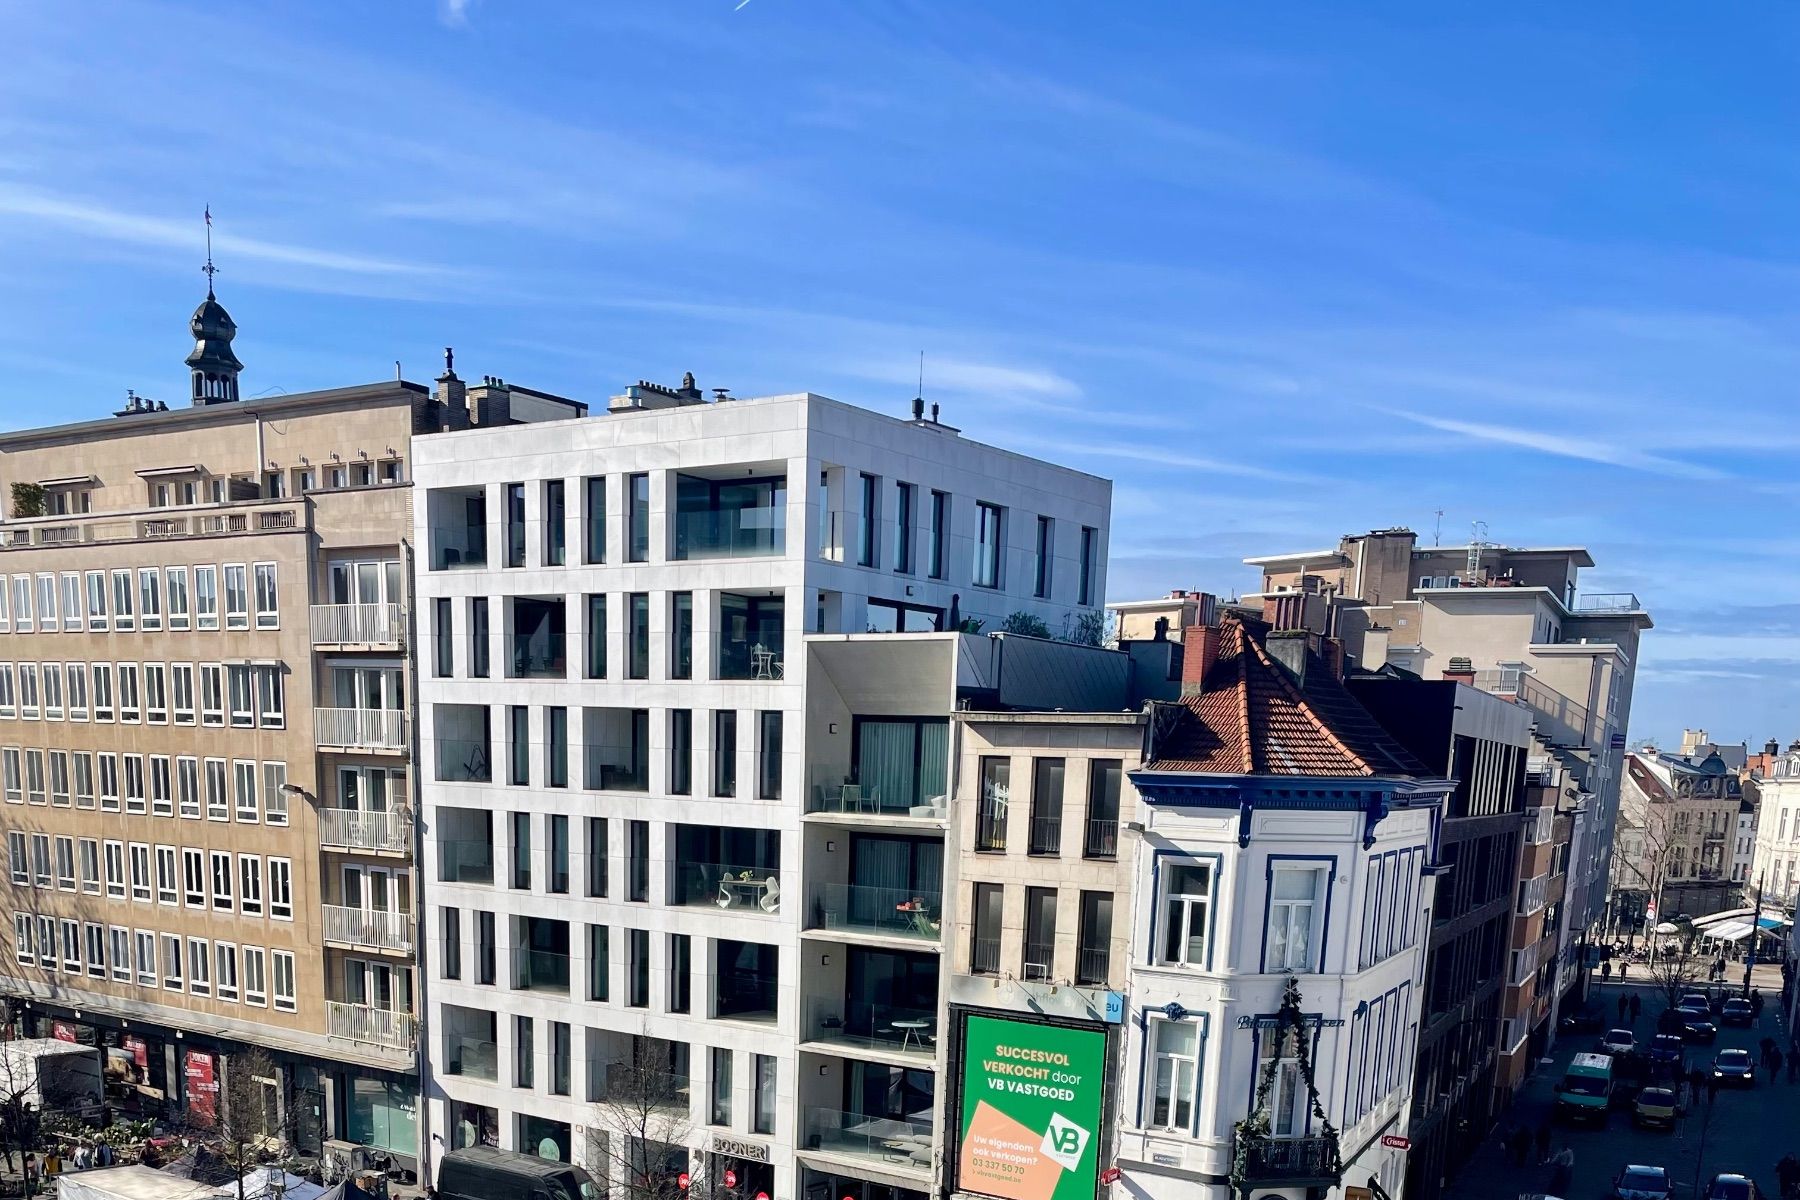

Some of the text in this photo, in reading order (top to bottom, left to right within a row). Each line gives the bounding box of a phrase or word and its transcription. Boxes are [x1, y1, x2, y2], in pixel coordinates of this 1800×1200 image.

[996, 1044, 1070, 1066] SUCCESVOL
[983, 1060, 1082, 1085] VERKOCHT door
[988, 1077, 1075, 1101] VB VASTGOED
[973, 1134, 1034, 1154] Uw eigendom
[1050, 1125, 1079, 1154] VB
[972, 1147, 1038, 1165] ook verkopen?
[972, 1158, 1025, 1175] 03 337 50 70
